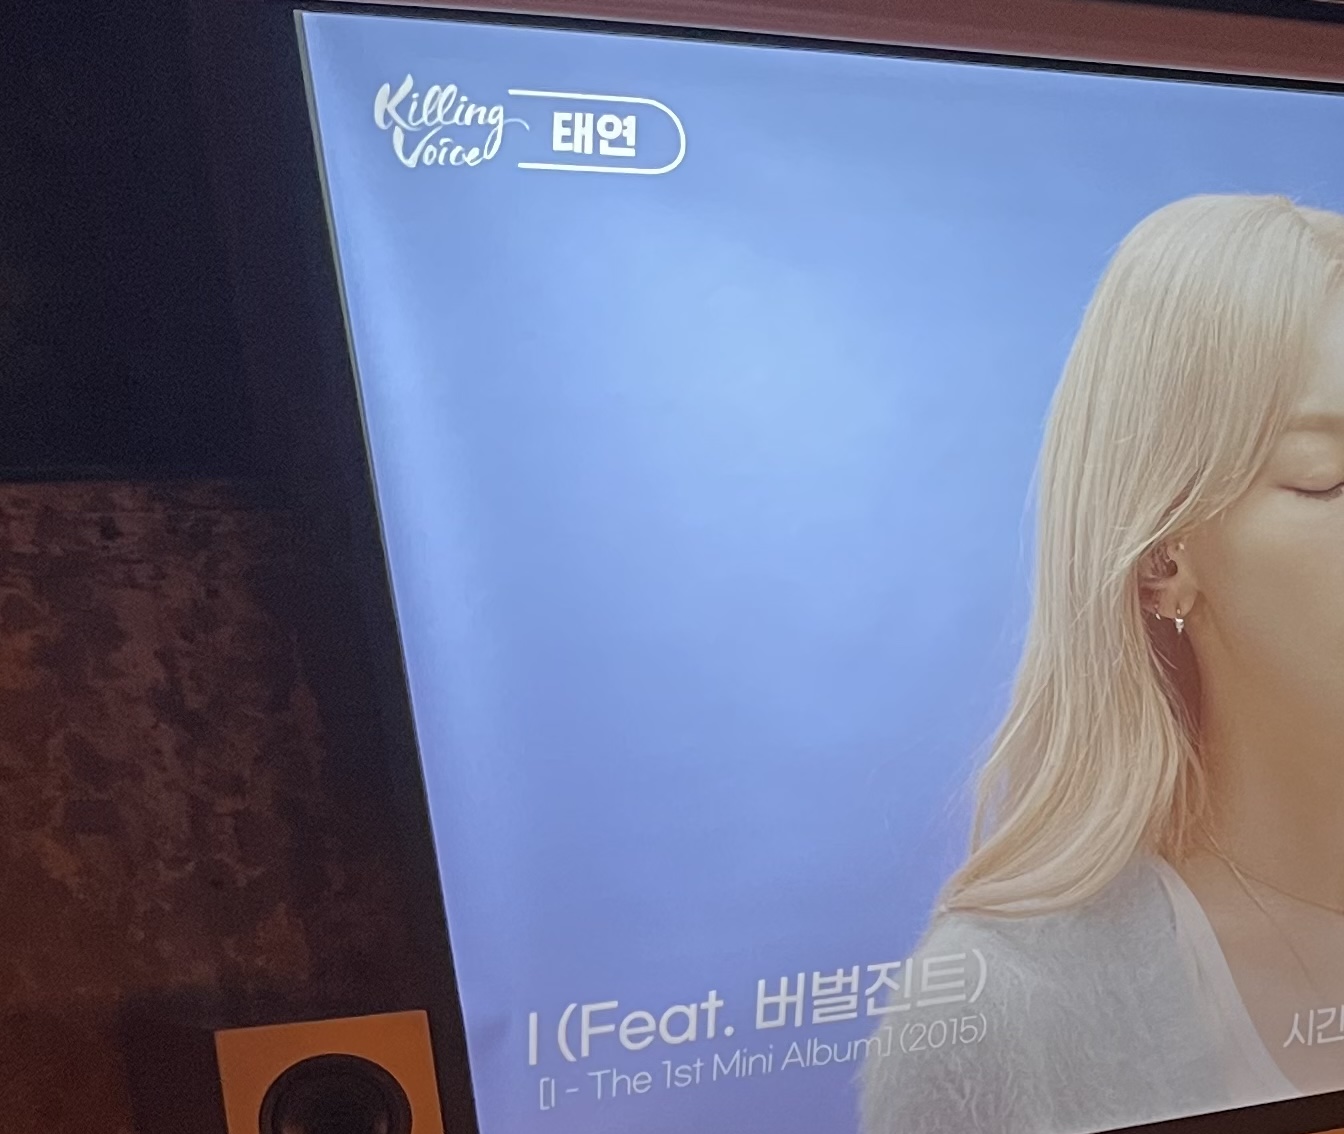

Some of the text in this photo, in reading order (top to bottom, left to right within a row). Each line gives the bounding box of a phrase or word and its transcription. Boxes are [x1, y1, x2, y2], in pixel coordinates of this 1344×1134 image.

[374, 73, 503, 159] Killing
[393, 125, 485, 168] Voice
[552, 111, 637, 157] 태연
[557, 990, 734, 1062] (Feat.
[755, 949, 987, 1029] 버벌진트)
[588, 1068, 652, 1100] The
[662, 1060, 703, 1088] 1st
[712, 1046, 773, 1081] Mini
[781, 1027, 893, 1072] Album]
[900, 1013, 987, 1054] (2015)
